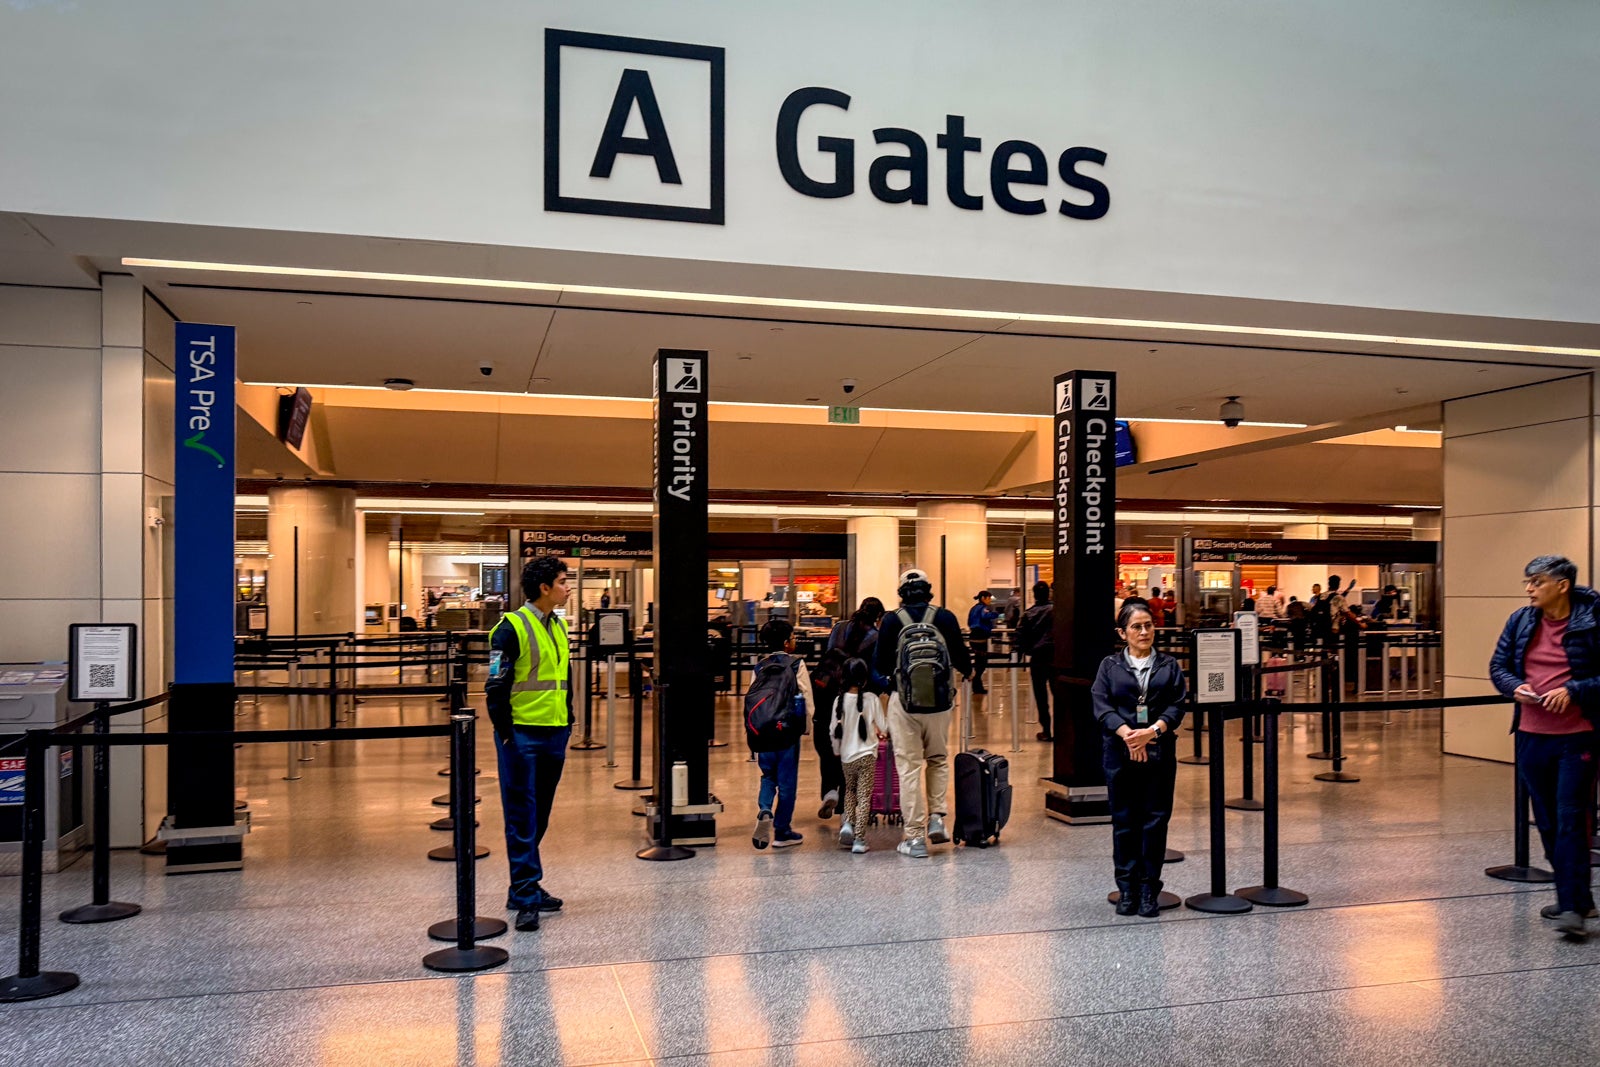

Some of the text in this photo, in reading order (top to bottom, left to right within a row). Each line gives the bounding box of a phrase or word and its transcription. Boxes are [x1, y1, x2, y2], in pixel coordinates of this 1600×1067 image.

[589, 68, 1111, 220] A Gates
[189, 336, 216, 431] TSA Pre
[834, 407, 859, 422] EXIT
[667, 402, 697, 502] Priority
[1056, 419, 1071, 555] Checkpoint
[1081, 418, 1107, 555] Checkpoint
[547, 533, 627, 543] Security Checkpoint
[1212, 541, 1272, 550] Security Checkpoint
[1, 760, 25, 770] SAF
